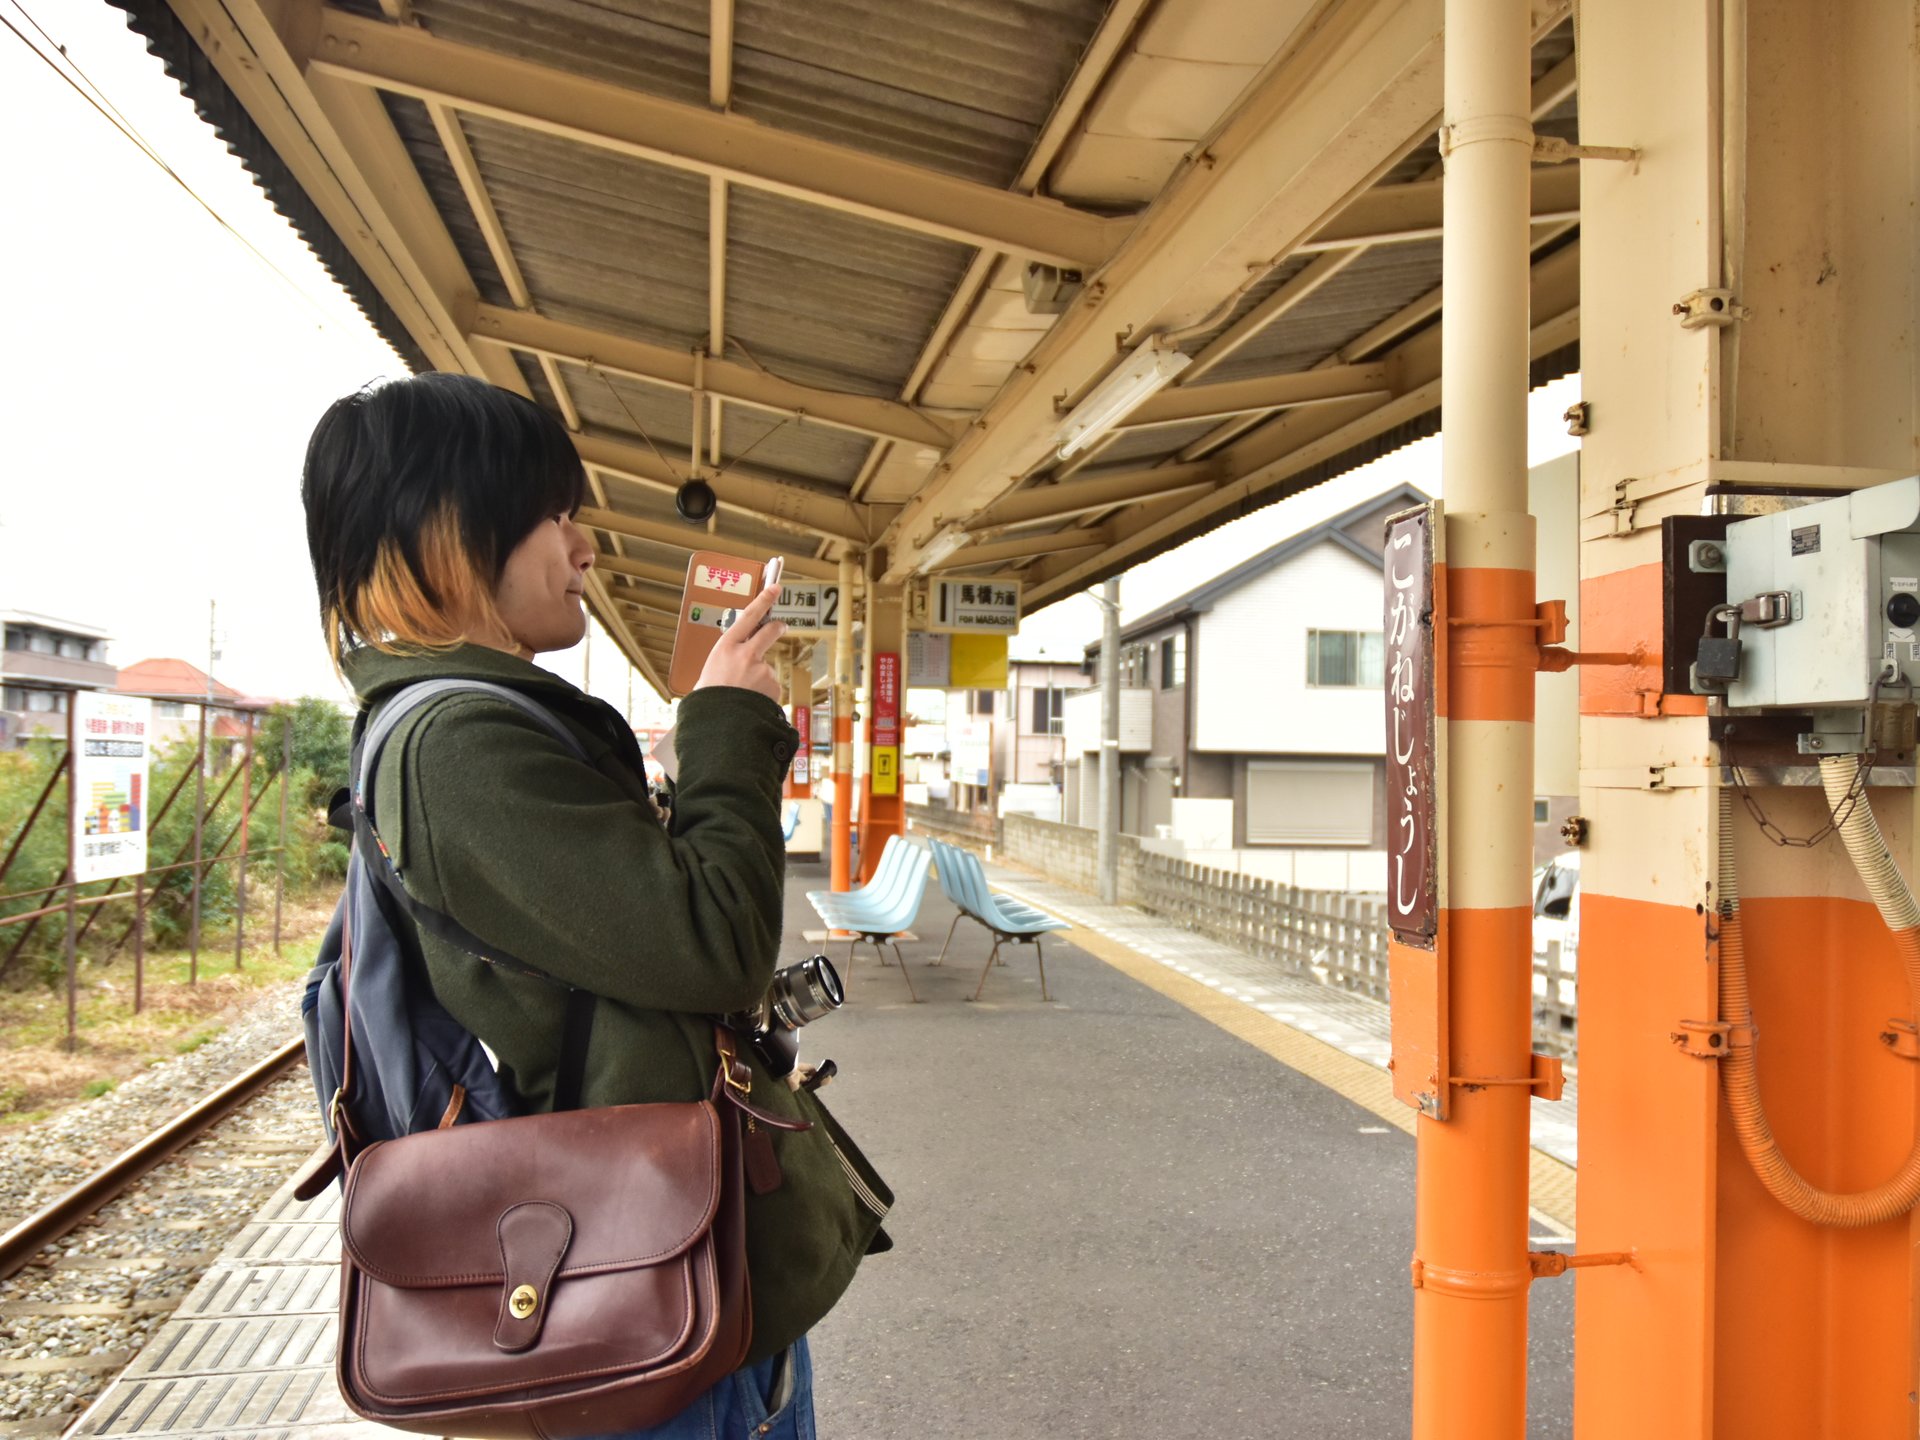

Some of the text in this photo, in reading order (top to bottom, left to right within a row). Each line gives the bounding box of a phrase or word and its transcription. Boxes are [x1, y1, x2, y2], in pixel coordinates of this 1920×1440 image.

[774, 587, 816, 607] 山方面
[823, 587, 839, 626] 2
[940, 582, 947, 622] 1
[961, 584, 1016, 606] 馬橋方面
[958, 615, 1016, 626] FOR MABASHI
[1390, 533, 1418, 915] こがねじょうし
